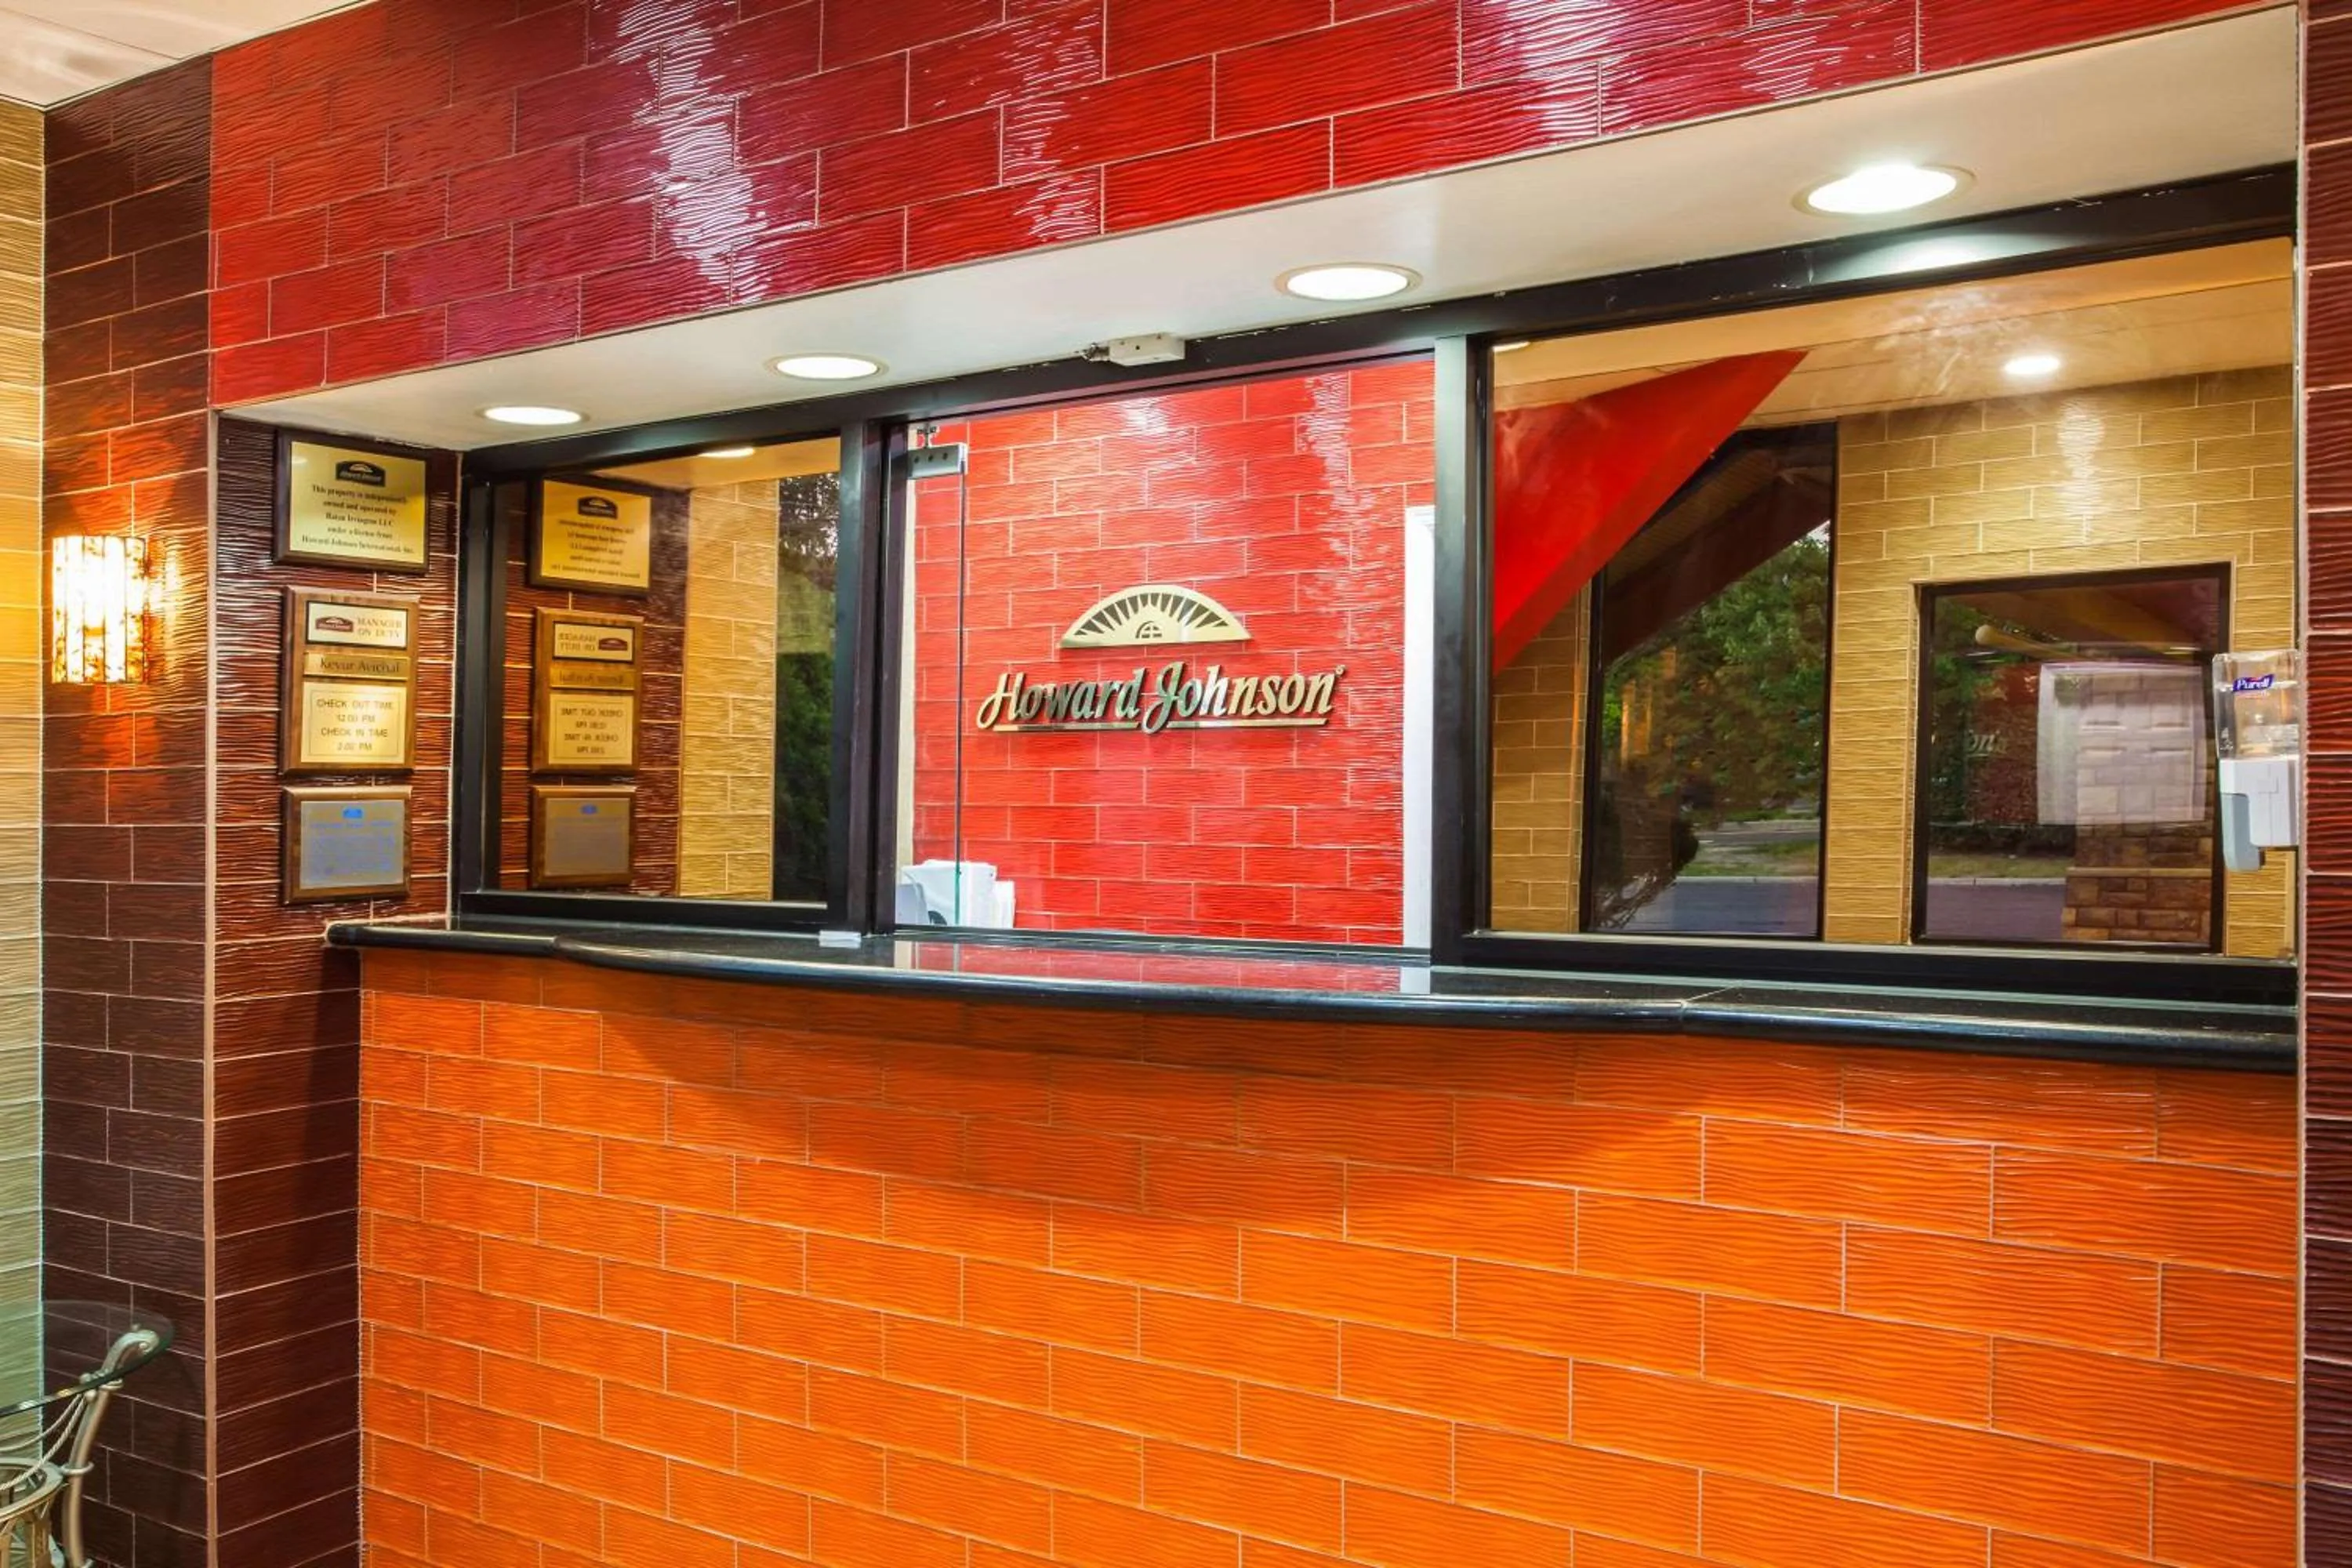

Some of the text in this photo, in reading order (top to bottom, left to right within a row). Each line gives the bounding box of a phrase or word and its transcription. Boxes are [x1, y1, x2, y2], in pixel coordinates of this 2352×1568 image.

[358, 617, 402, 629] MANAGER
[976, 666, 1146, 730] Howard
[317, 698, 394, 710] CHECK OUT TIME
[361, 714, 376, 724] PM
[321, 727, 389, 738] CHECK IN TIME
[358, 742, 372, 751] PM
